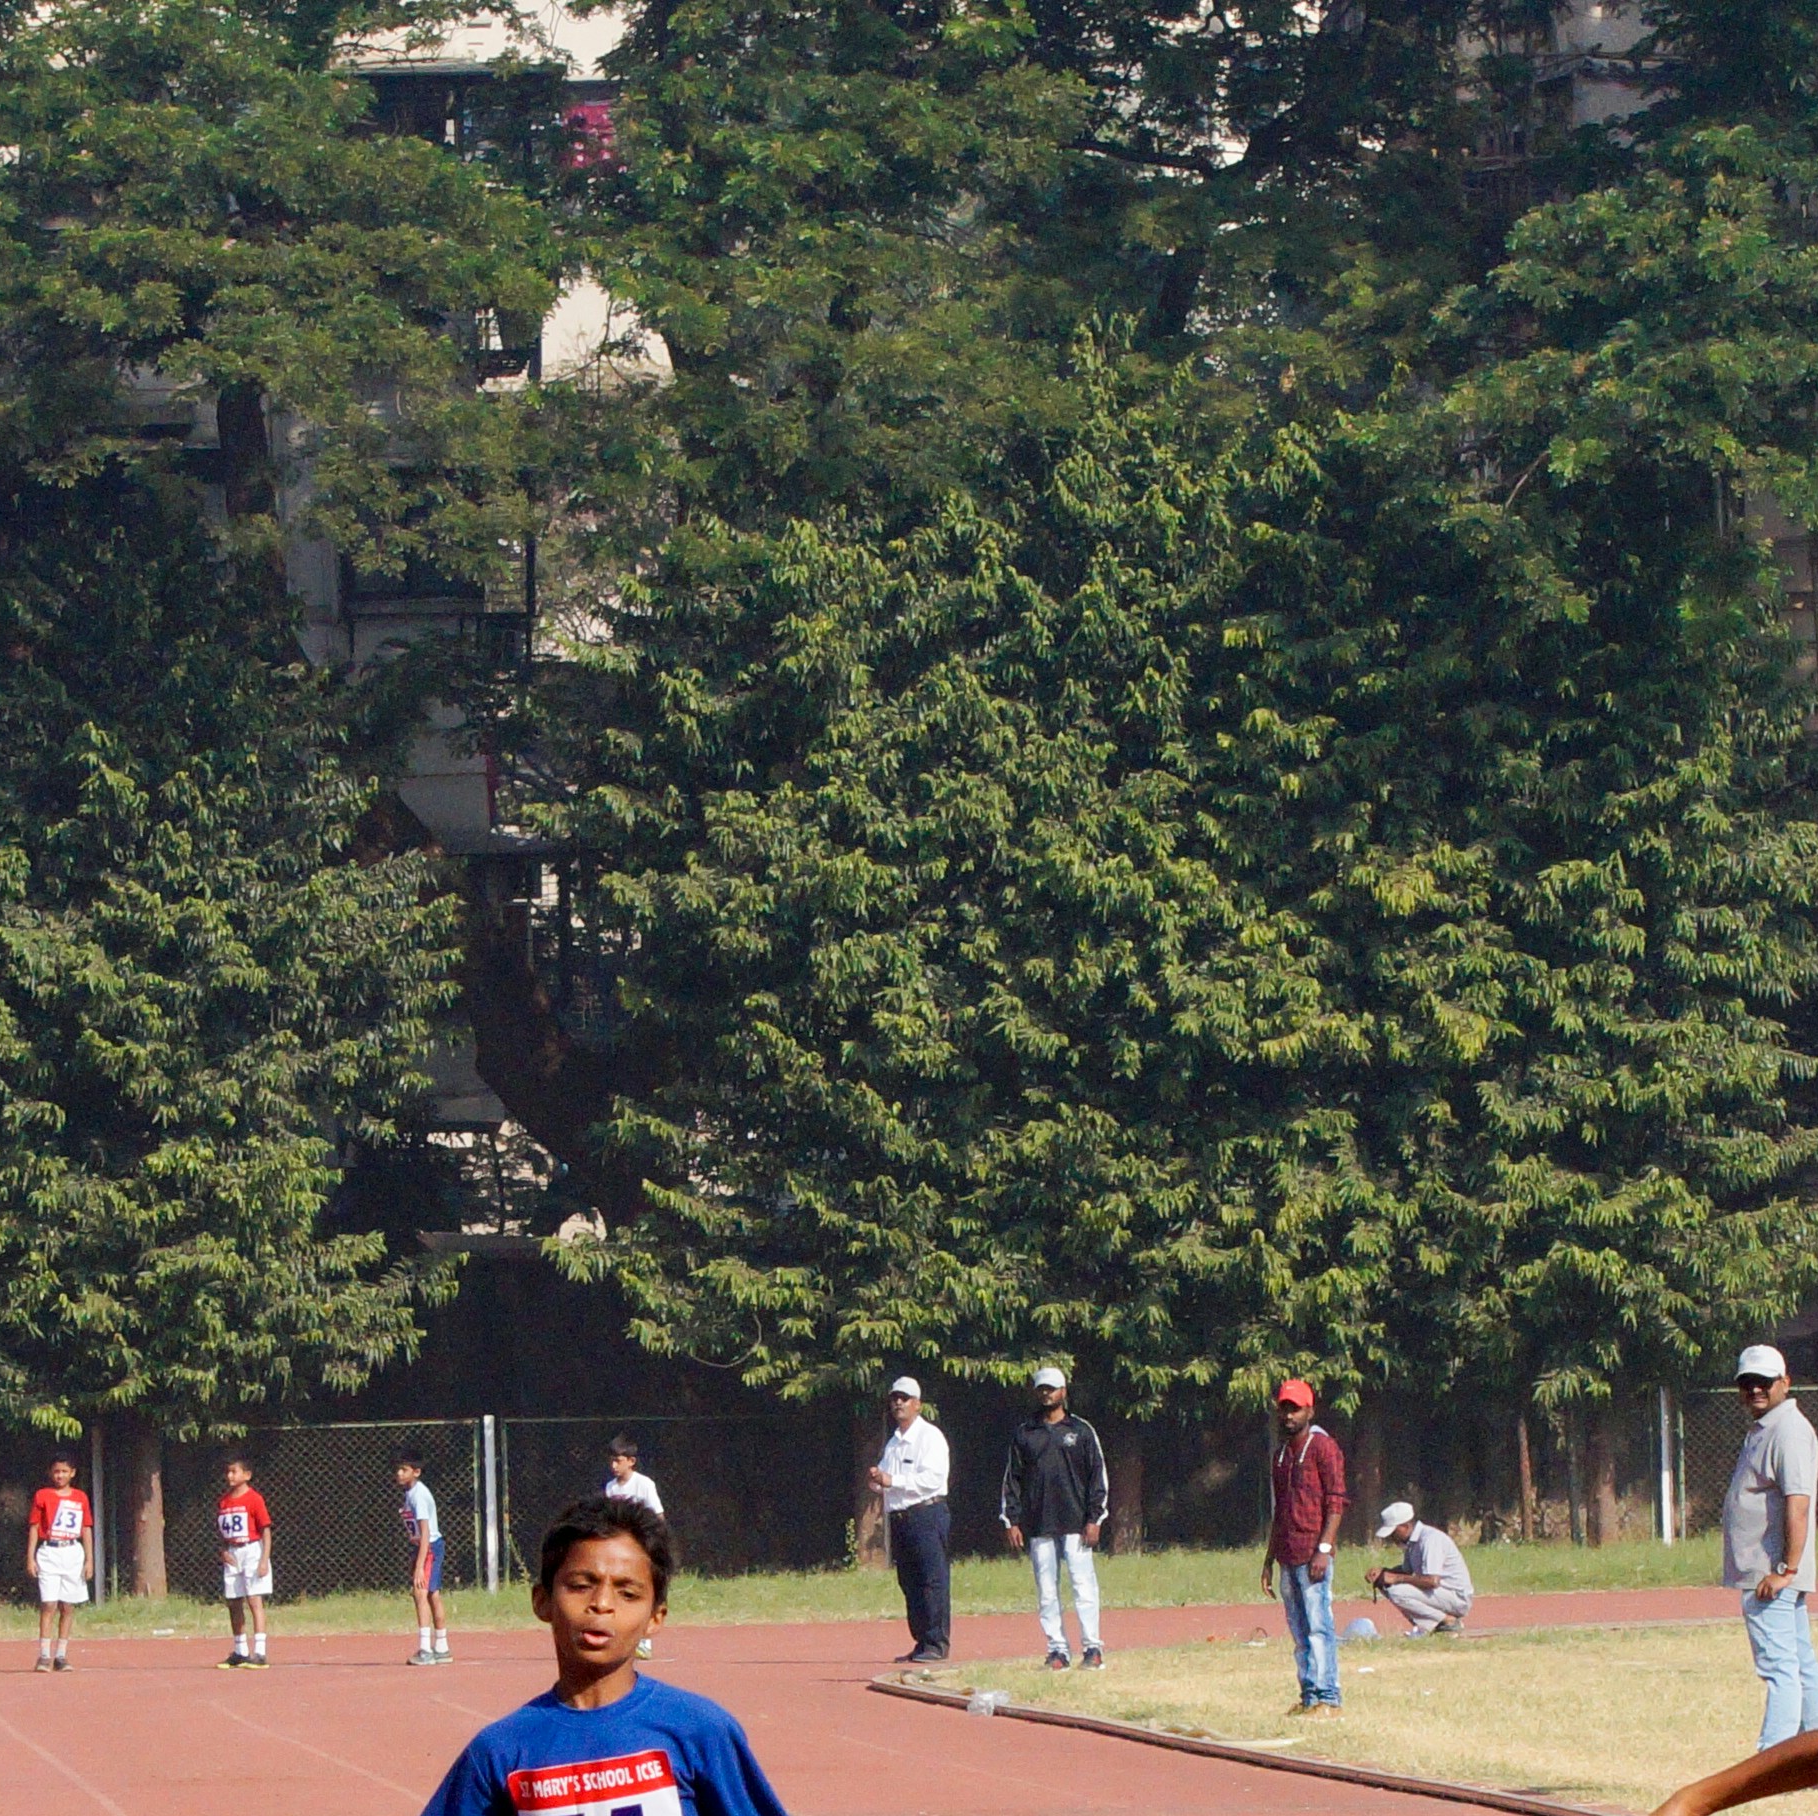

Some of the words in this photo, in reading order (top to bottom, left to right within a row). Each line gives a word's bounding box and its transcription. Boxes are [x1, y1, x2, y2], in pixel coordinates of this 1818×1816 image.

[222, 1515, 243, 1534] 48
[532, 1775, 581, 1798] MARY'S
[583, 1769, 634, 1791] SCHOOL
[636, 1760, 663, 1782] ICSE
